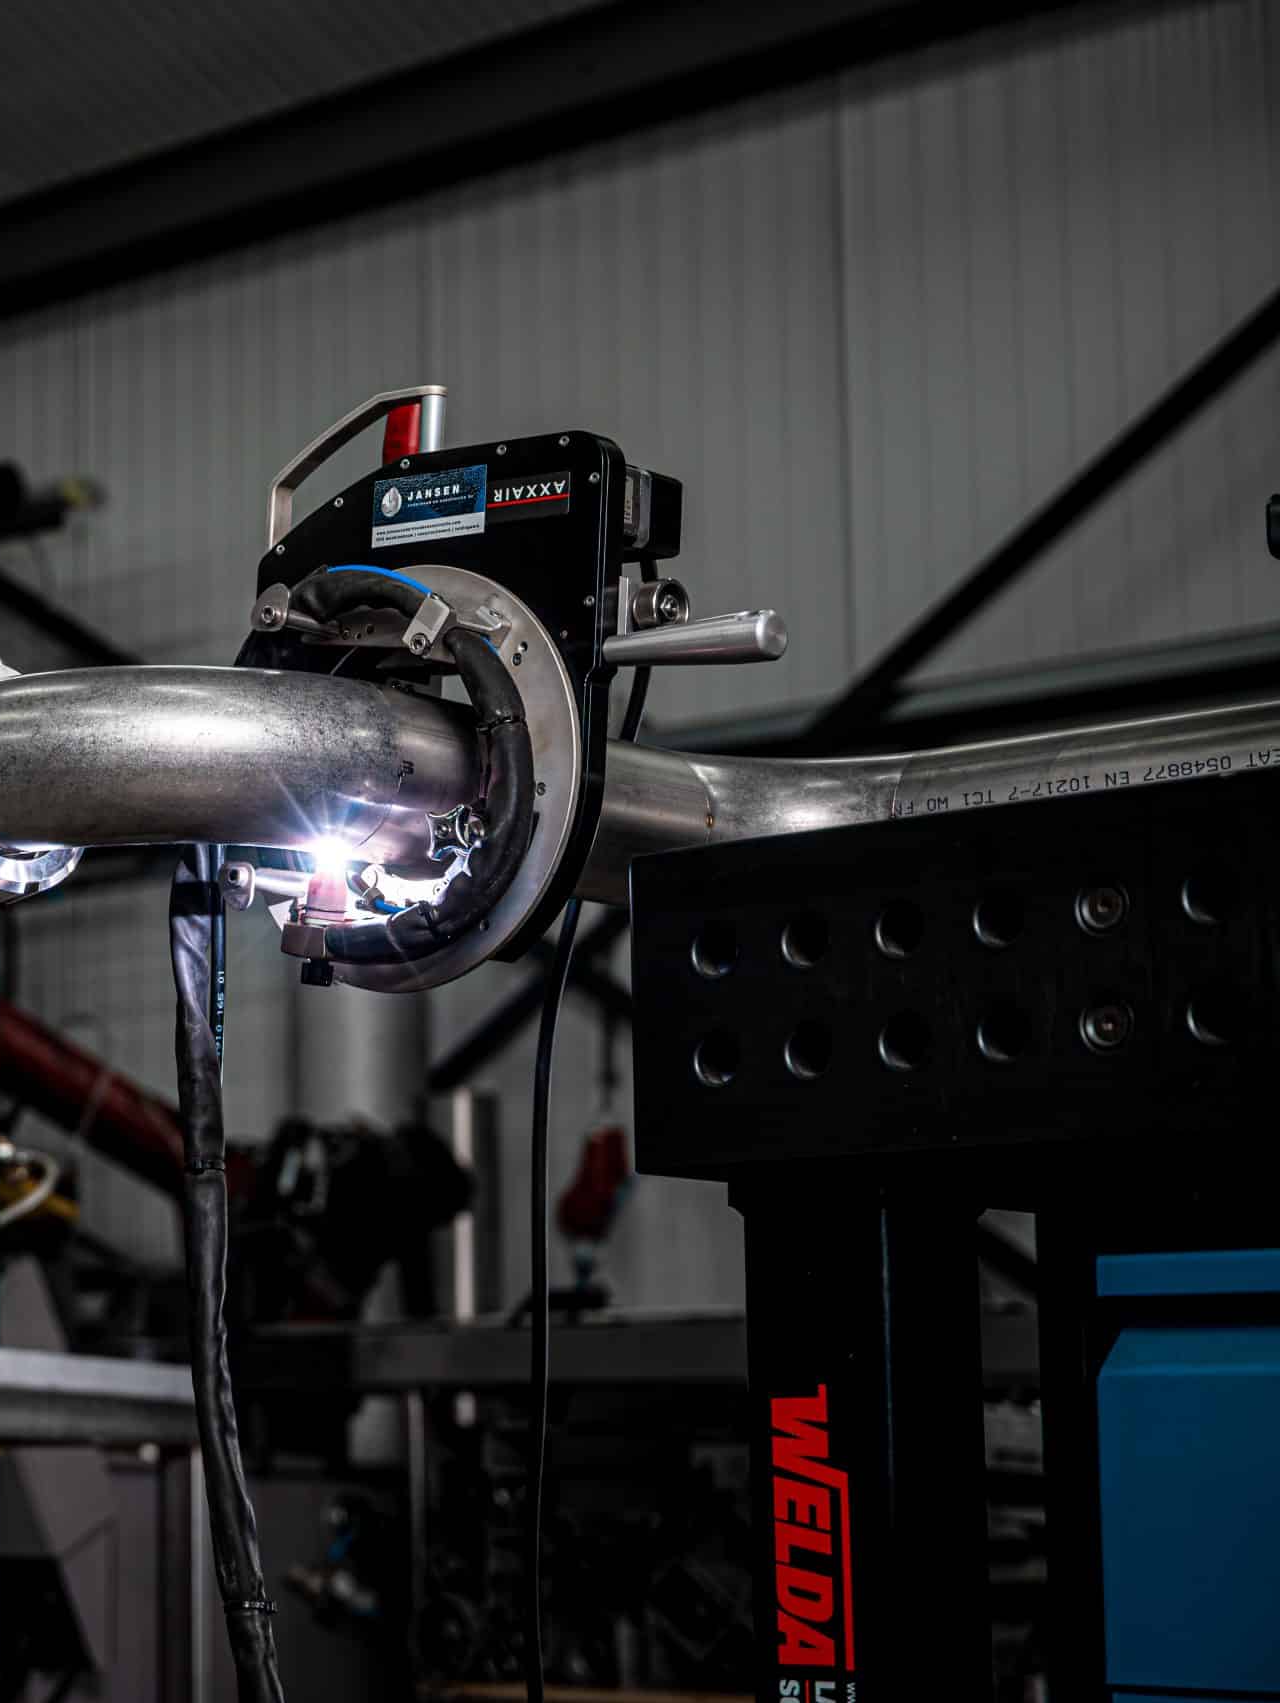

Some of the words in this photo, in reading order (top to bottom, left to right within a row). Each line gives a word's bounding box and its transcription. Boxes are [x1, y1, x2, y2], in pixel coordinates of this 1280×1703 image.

[407, 484, 460, 501] JANSEN
[493, 480, 566, 502] AXXAIR
[1105, 771, 1129, 787] EN
[1144, 756, 1231, 782] 0548877
[1008, 775, 1090, 801] 10217-7
[770, 1383, 850, 1667] WELDA
